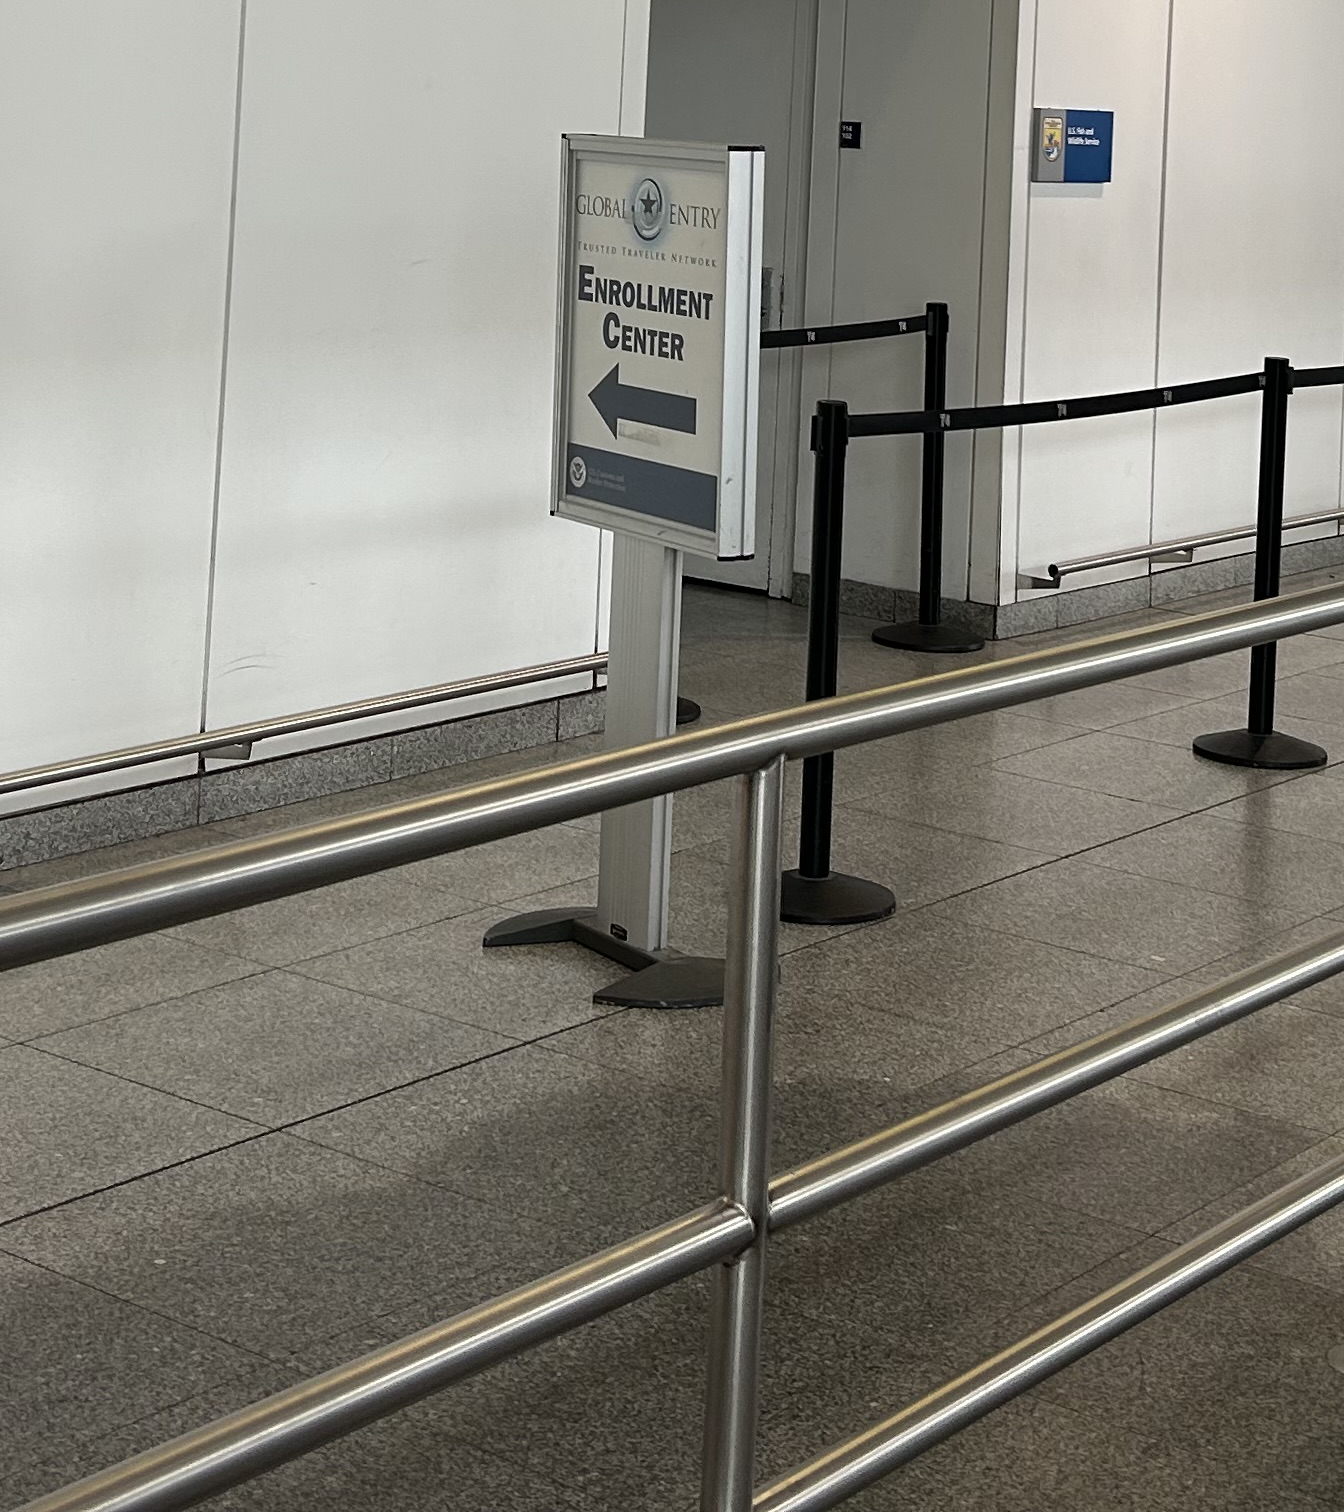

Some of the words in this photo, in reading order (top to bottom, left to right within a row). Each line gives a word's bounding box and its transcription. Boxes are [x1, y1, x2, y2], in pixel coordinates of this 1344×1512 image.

[576, 194, 626, 219] GLOBAL
[669, 203, 721, 230] ENTRY
[577, 241, 617, 255] TRUSTED
[622, 246, 666, 262] TRAVELER
[671, 253, 717, 268] NETWORK
[578, 264, 713, 320] ENROLLMENT
[603, 311, 684, 362] CENTER
